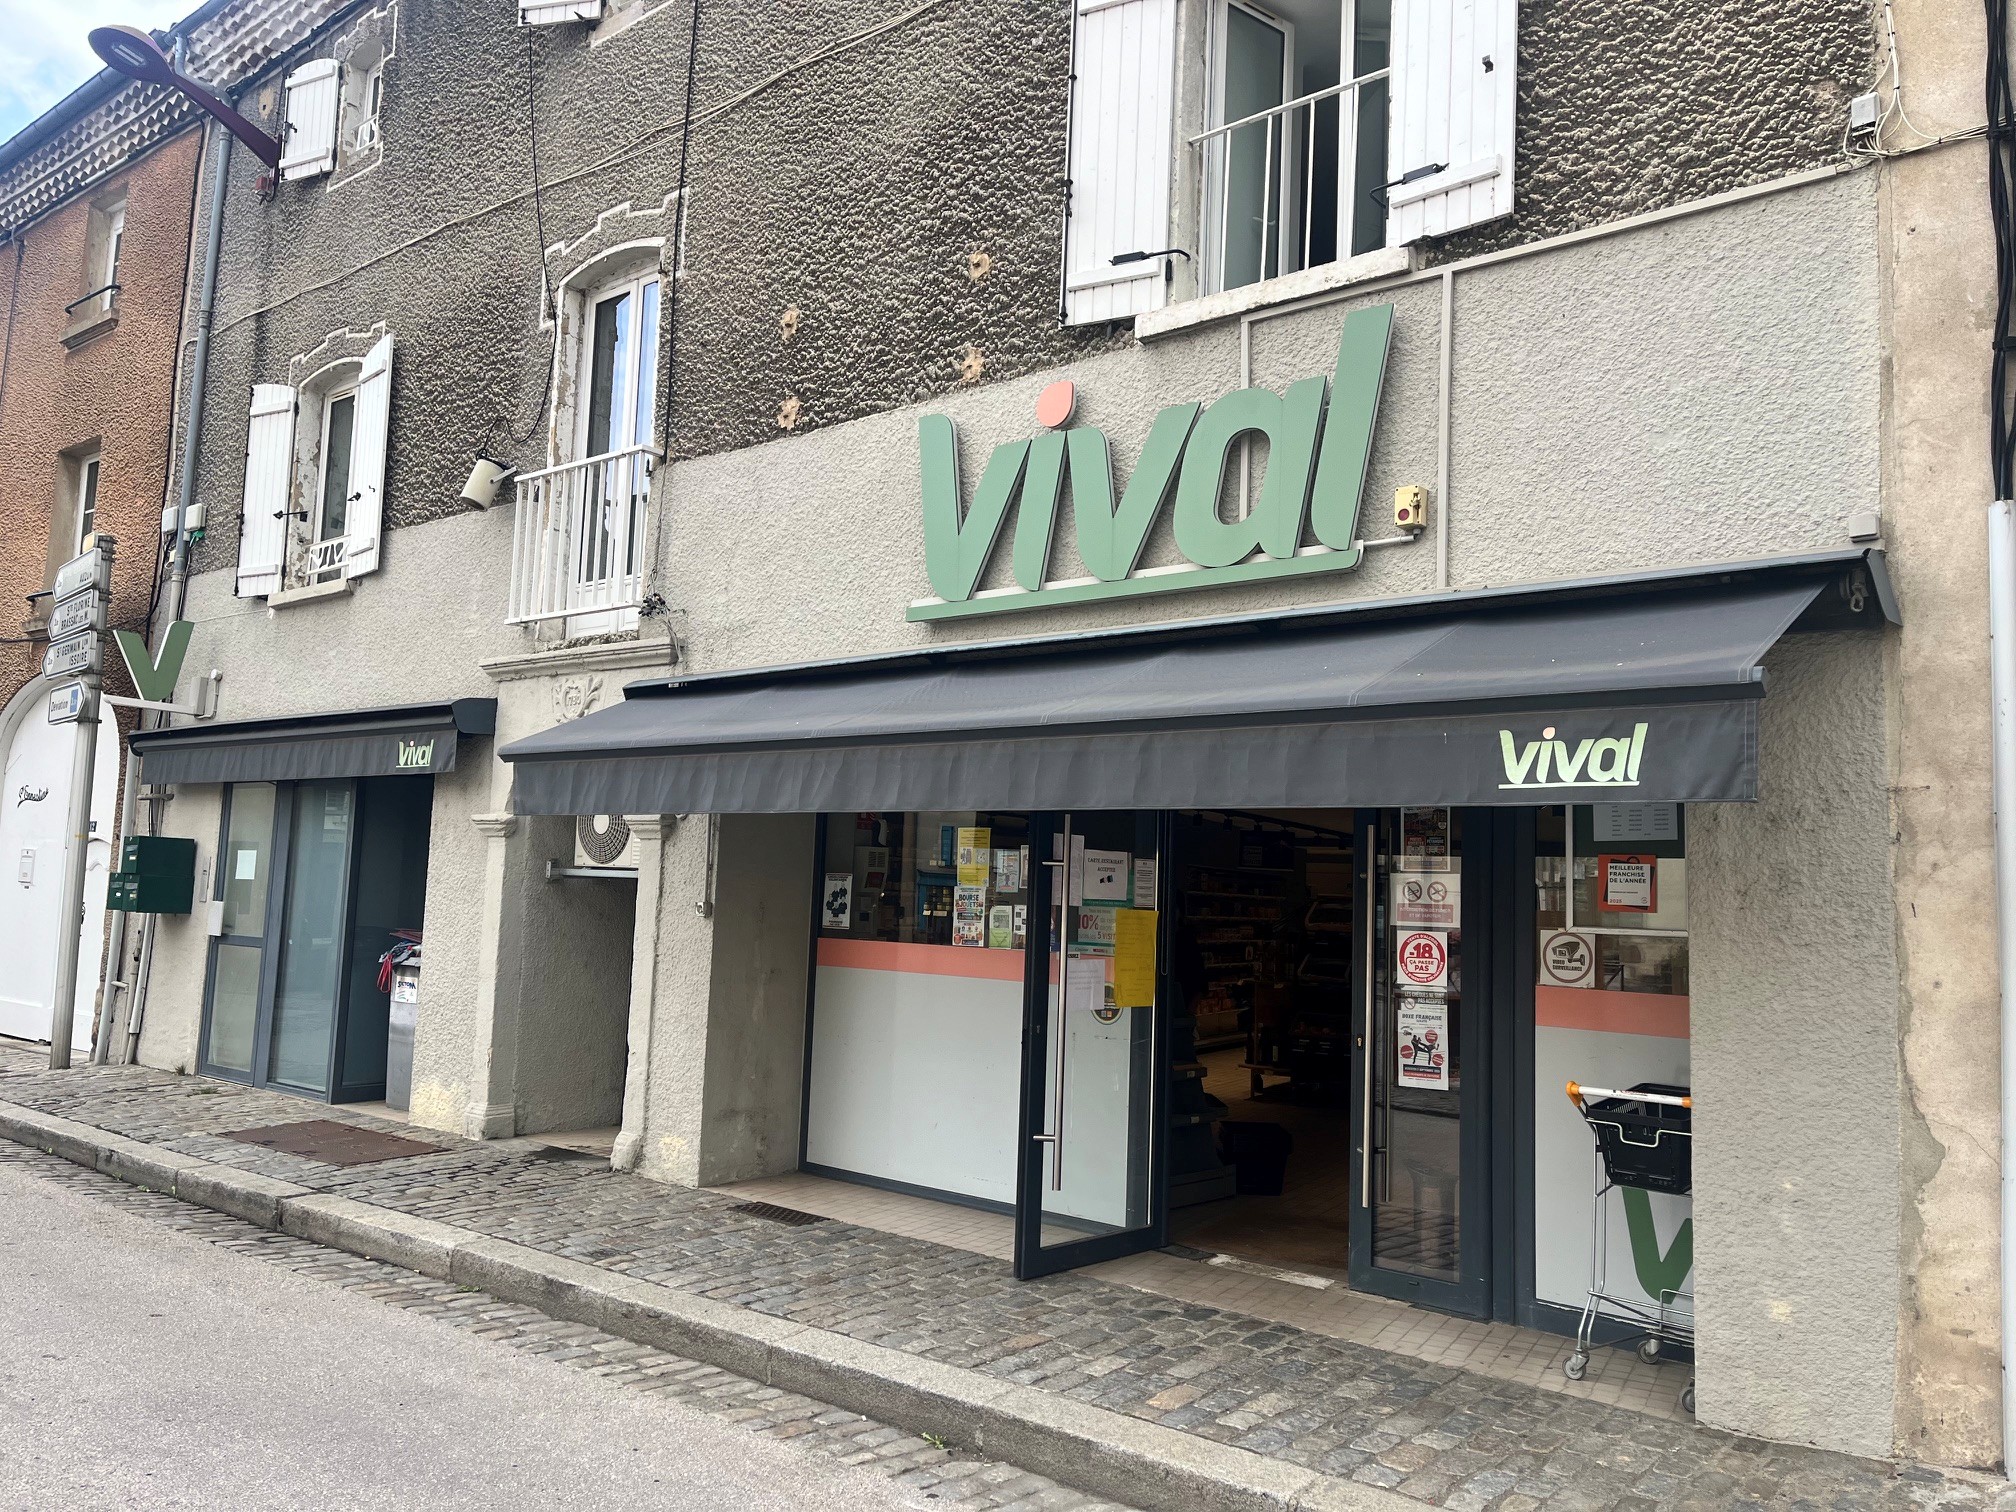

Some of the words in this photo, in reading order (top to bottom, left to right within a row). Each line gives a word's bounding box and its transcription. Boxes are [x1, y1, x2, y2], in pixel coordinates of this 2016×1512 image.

[62, 642, 80, 657] GERMAIN
[68, 650, 88, 667] ISSOIRE
[958, 894, 980, 902] BOURSE
[1098, 932, 1102, 940] 5
[1409, 942, 1433, 958] -18
